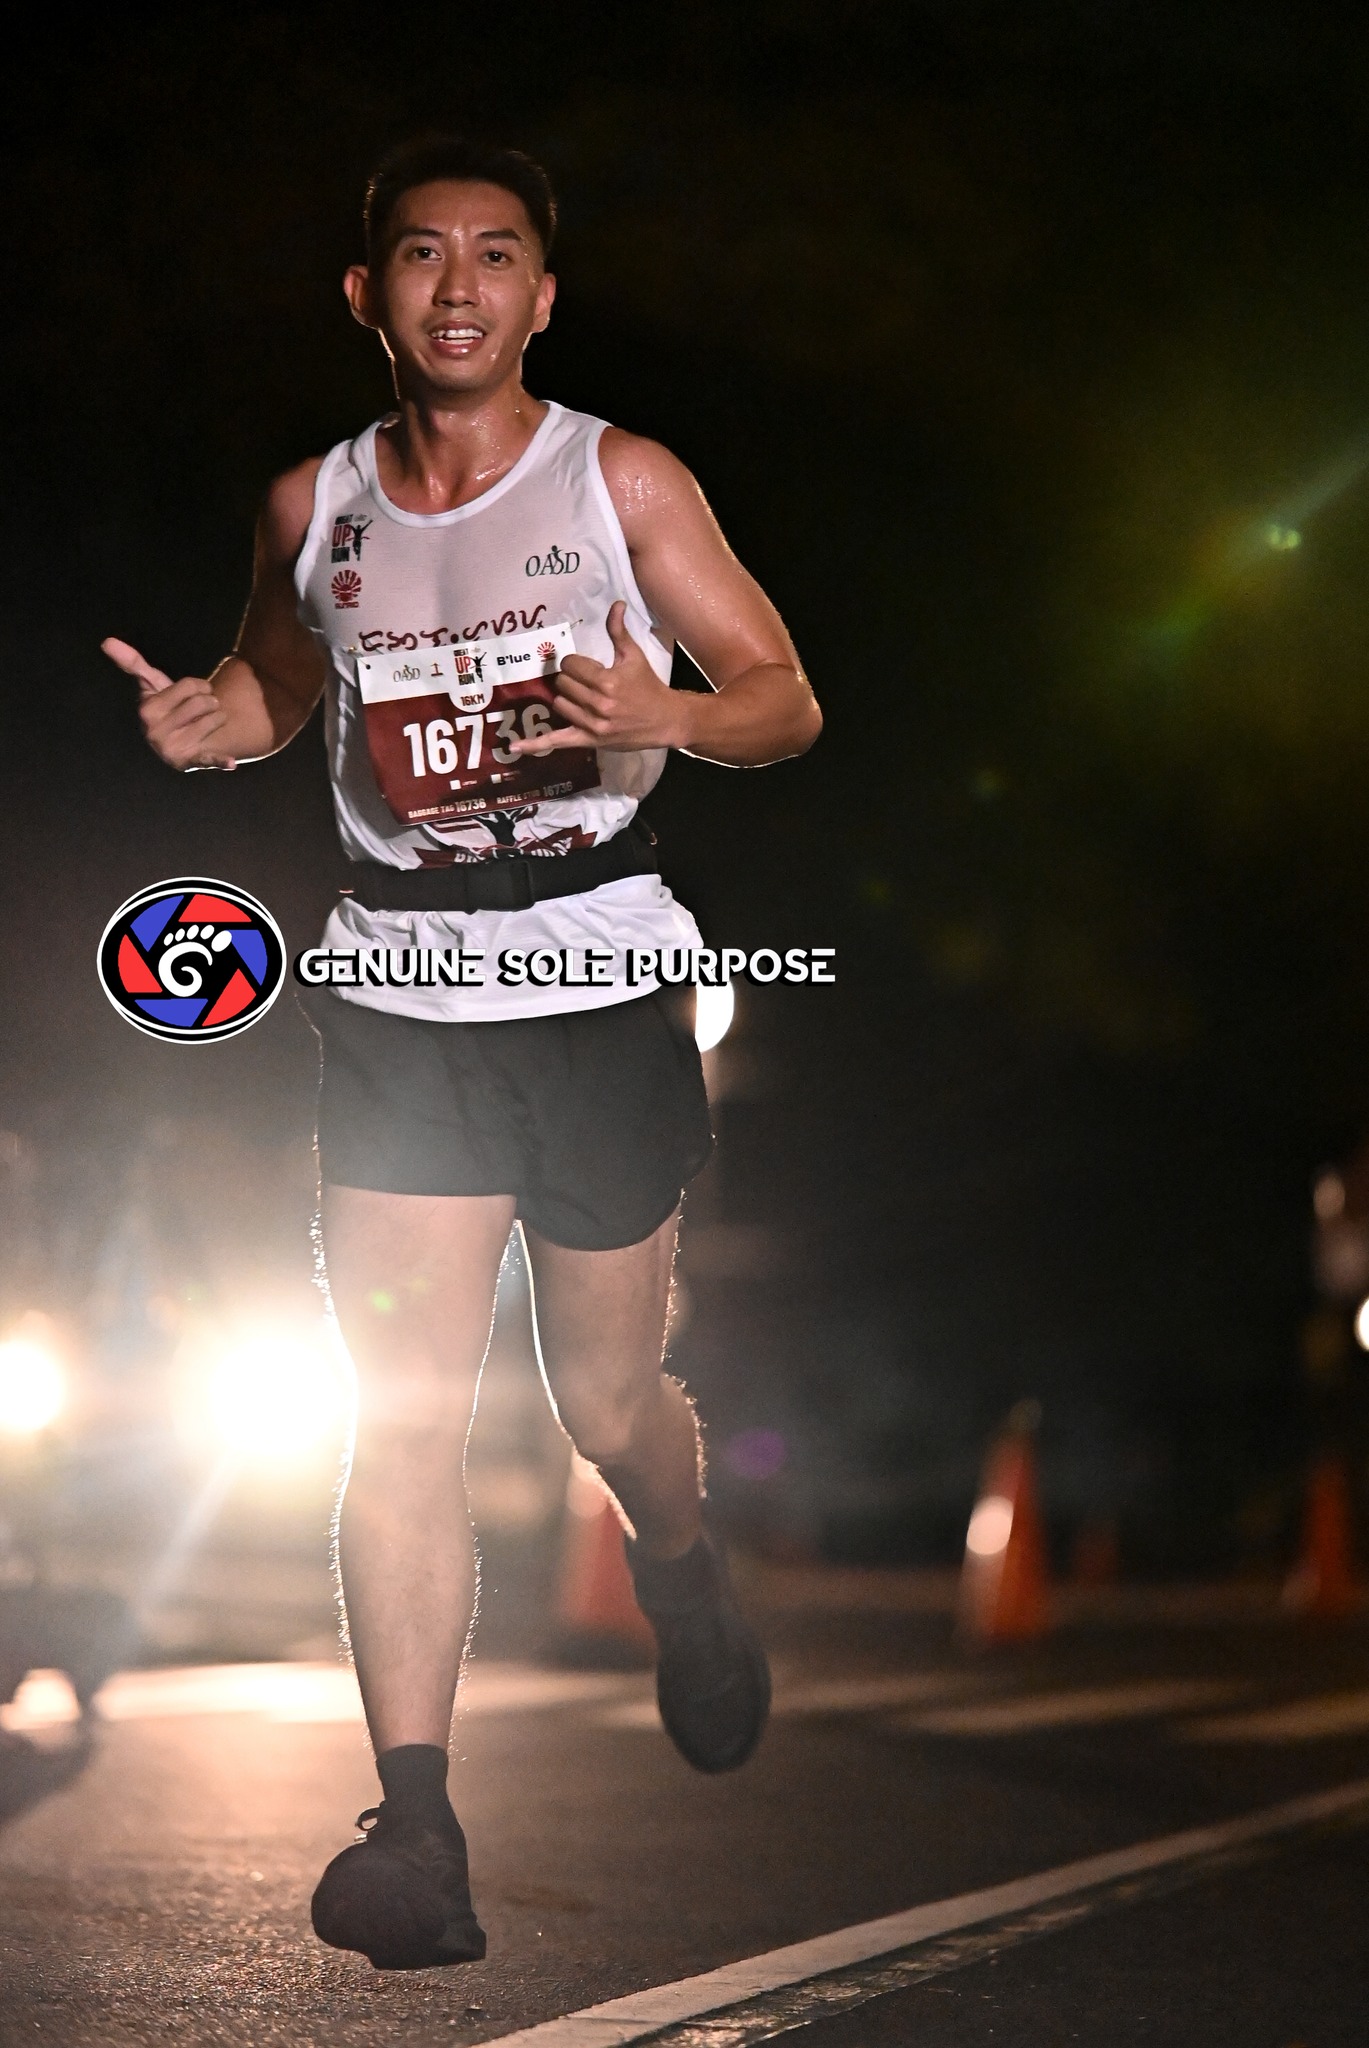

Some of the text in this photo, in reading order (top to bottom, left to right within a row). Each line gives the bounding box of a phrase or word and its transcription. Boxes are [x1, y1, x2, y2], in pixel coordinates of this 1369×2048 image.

[332, 524, 353, 548] UP
[525, 545, 580, 577] OASD
[454, 656, 471, 674] UP
[496, 653, 531, 666] B'lue
[393, 665, 420, 682] OASD
[460, 693, 485, 706] 16KM
[403, 704, 555, 777] 16736
[496, 794, 522, 804] RAFFLE
[542, 780, 574, 797] 16736
[408, 798, 487, 819] BAGGAGE TAG 16736
